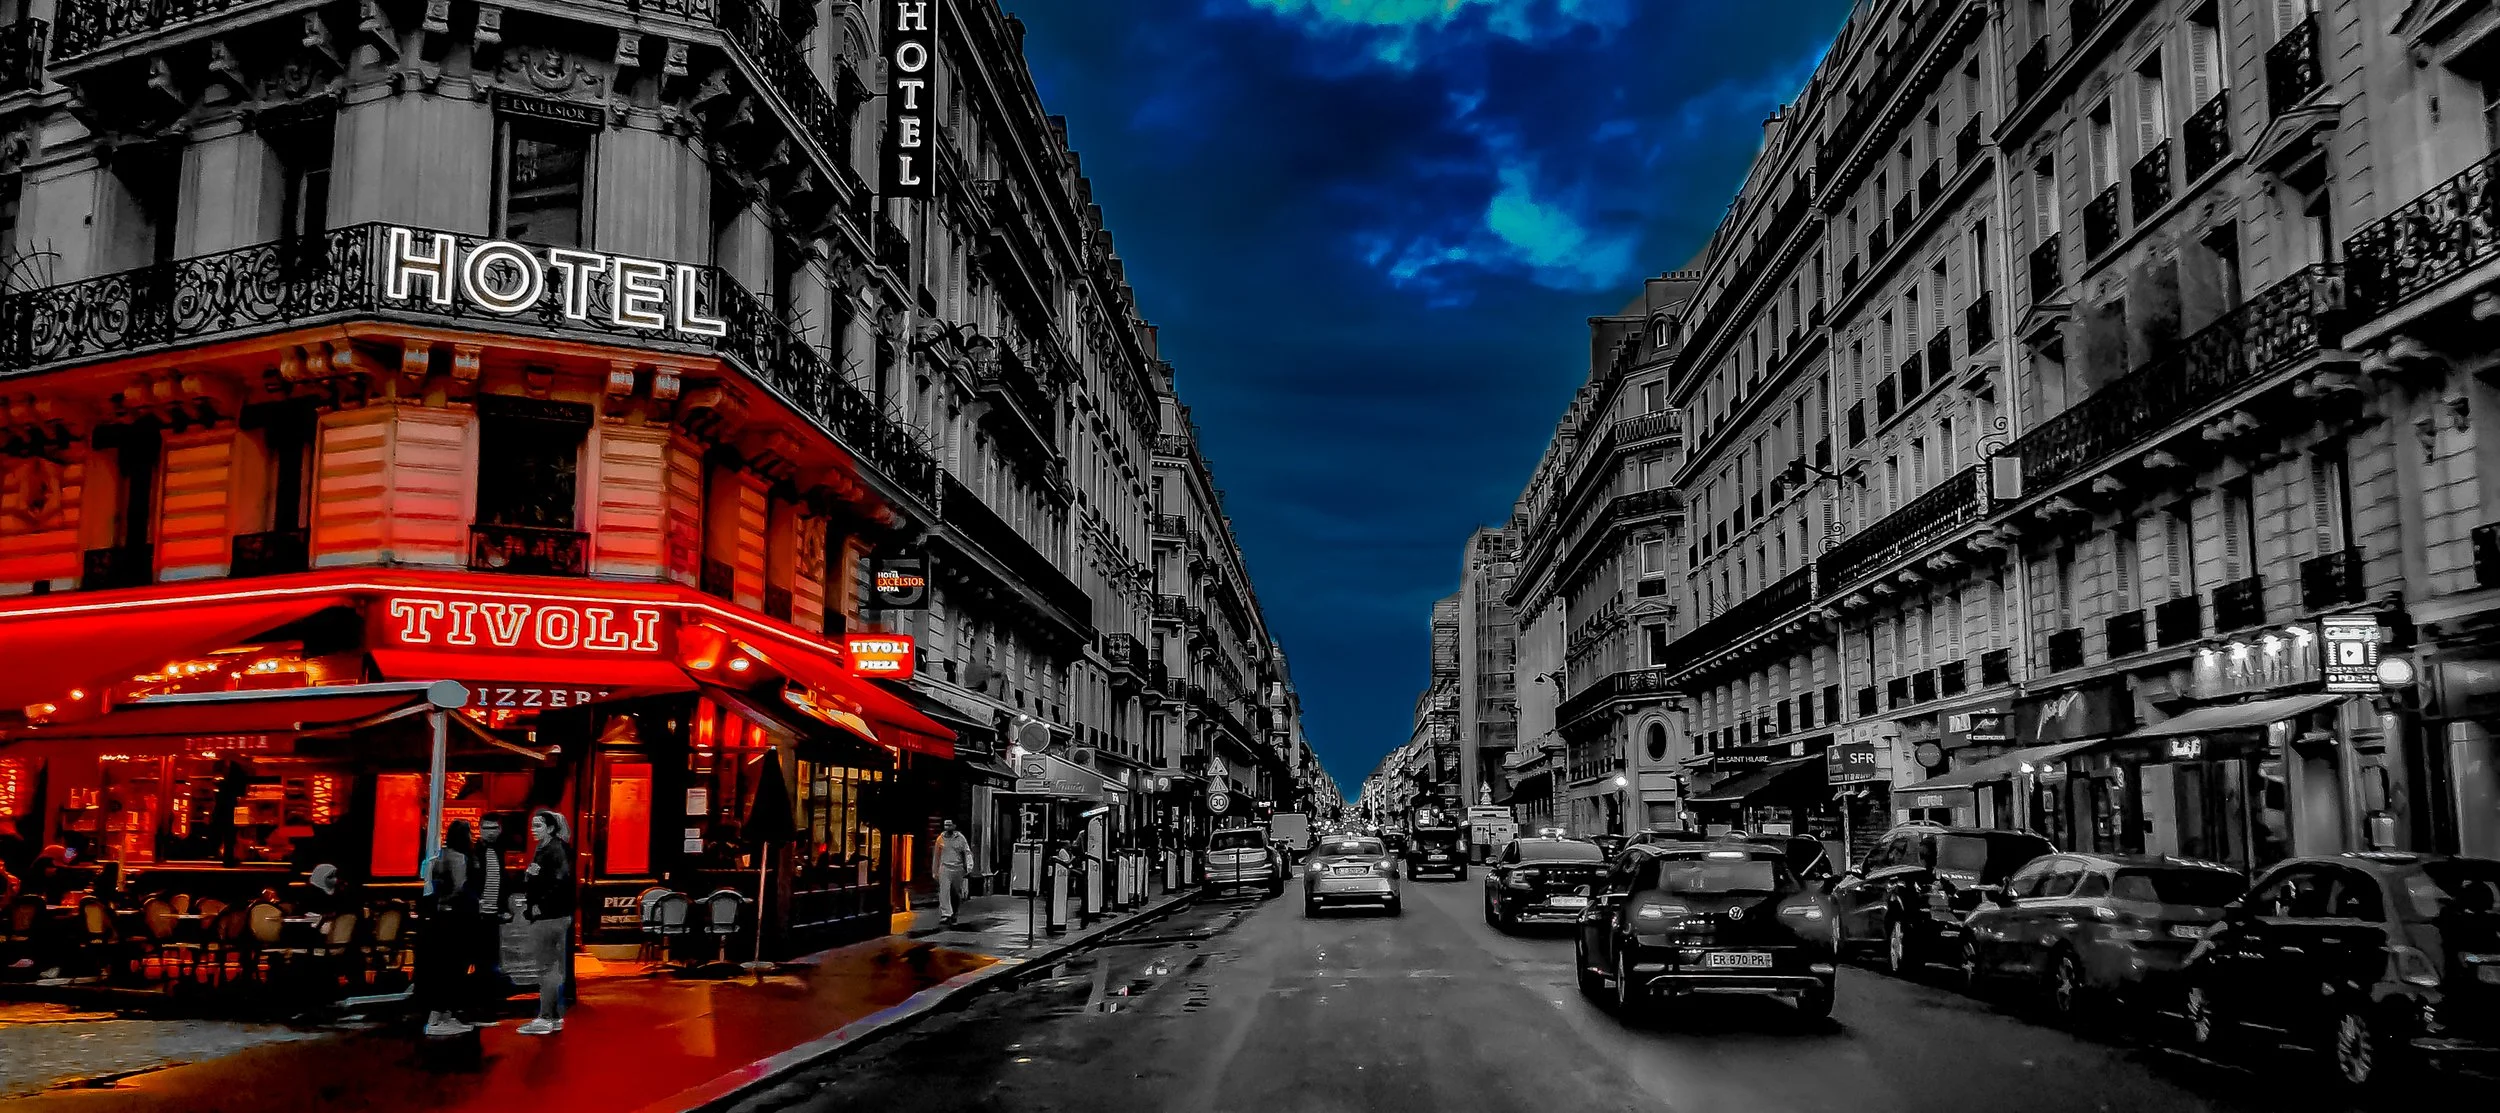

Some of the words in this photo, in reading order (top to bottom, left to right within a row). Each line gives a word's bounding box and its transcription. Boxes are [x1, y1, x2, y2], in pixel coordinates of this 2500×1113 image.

[896, 2, 928, 186] HOTEL
[387, 227, 728, 337] HOTEL
[877, 577, 925, 587] EXCELSIOR
[391, 598, 660, 651] TIVOLI
[850, 641, 910, 654] TIVOLI
[859, 660, 900, 670] PIZZA
[1849, 752, 1875, 764] SFR
[1213, 798, 1224, 807] 30
[1713, 955, 1726, 965] ER
[1730, 955, 1748, 965] 870
[1751, 955, 1765, 965] PR
